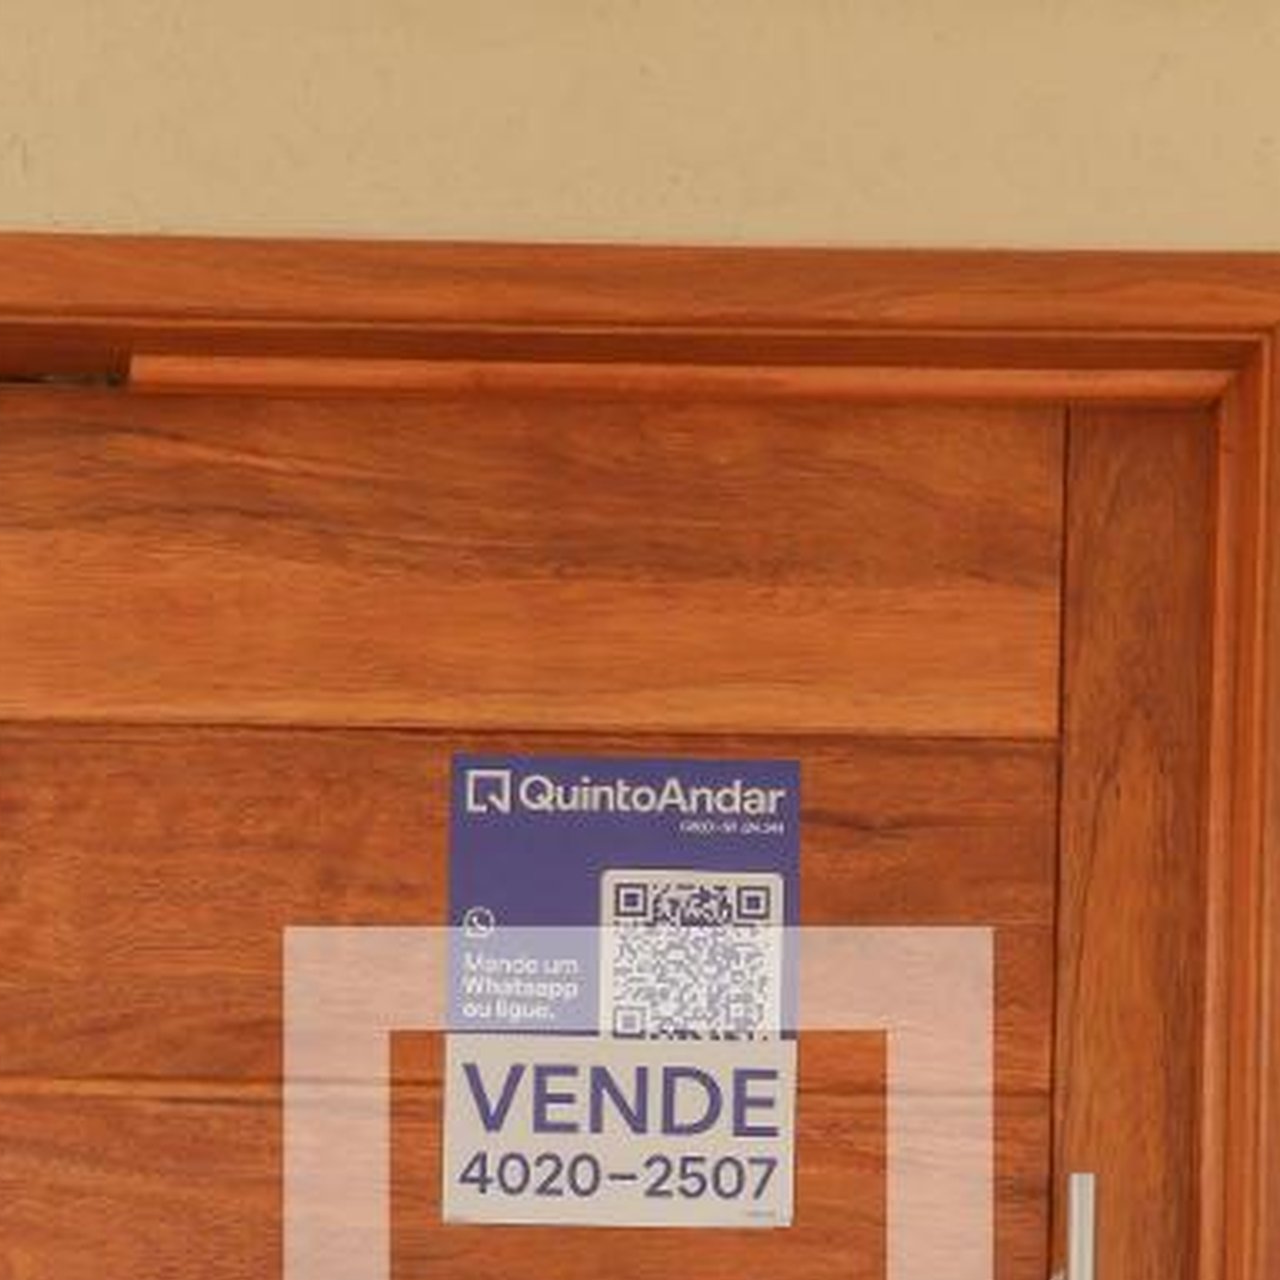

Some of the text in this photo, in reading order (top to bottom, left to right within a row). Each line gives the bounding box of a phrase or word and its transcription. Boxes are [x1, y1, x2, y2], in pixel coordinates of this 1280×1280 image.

[520, 775, 784, 815] QuintoAndar
[543, 959, 579, 974] um
[462, 1002, 491, 1018] ou
[462, 1063, 780, 1138] VENDE
[459, 1152, 779, 1199] 4020-2507
